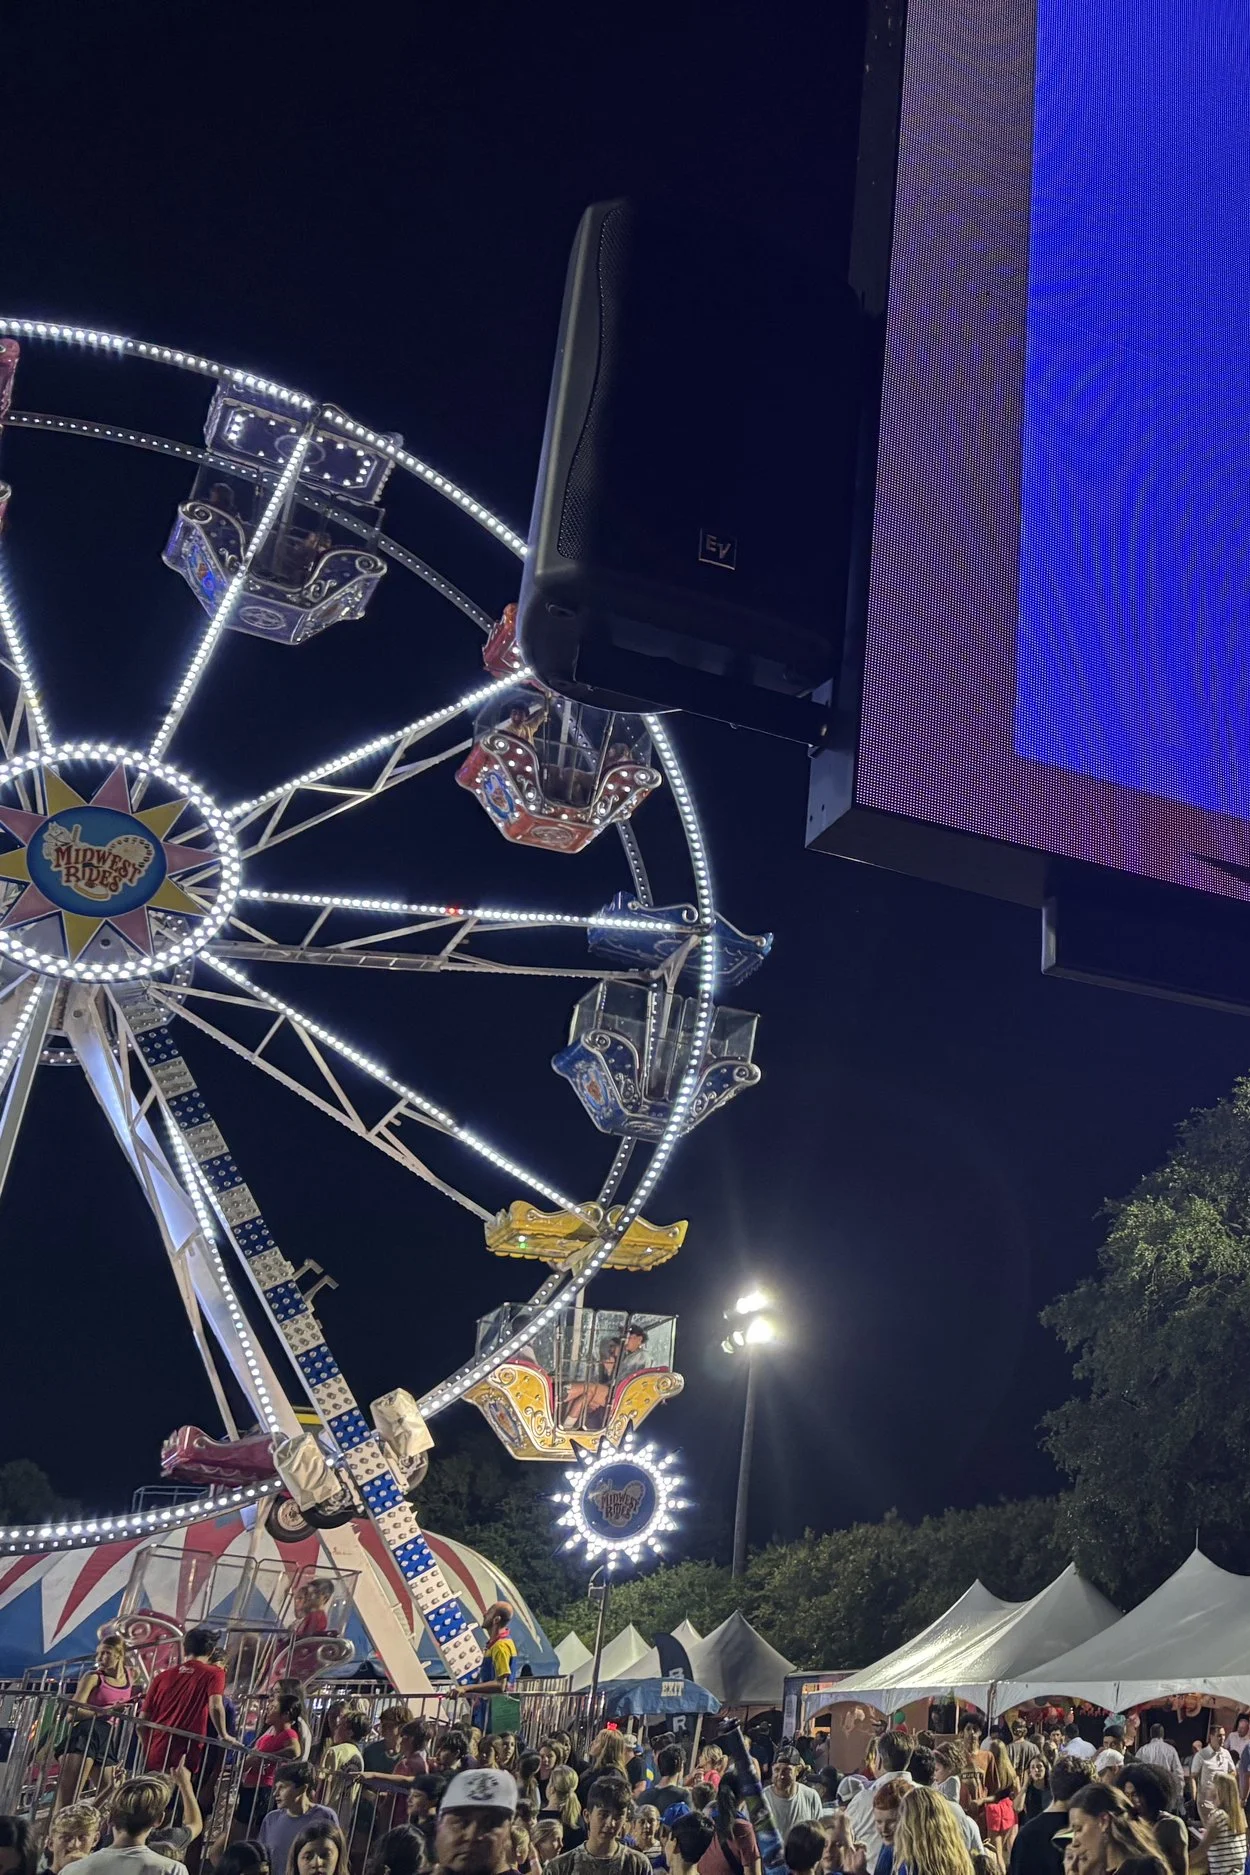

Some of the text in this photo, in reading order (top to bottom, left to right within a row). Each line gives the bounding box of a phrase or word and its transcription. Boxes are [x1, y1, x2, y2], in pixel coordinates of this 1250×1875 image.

[53, 844, 142, 884] MIDWEST
[64, 865, 124, 893] RIDES
[661, 1681, 685, 1697] EXIT
